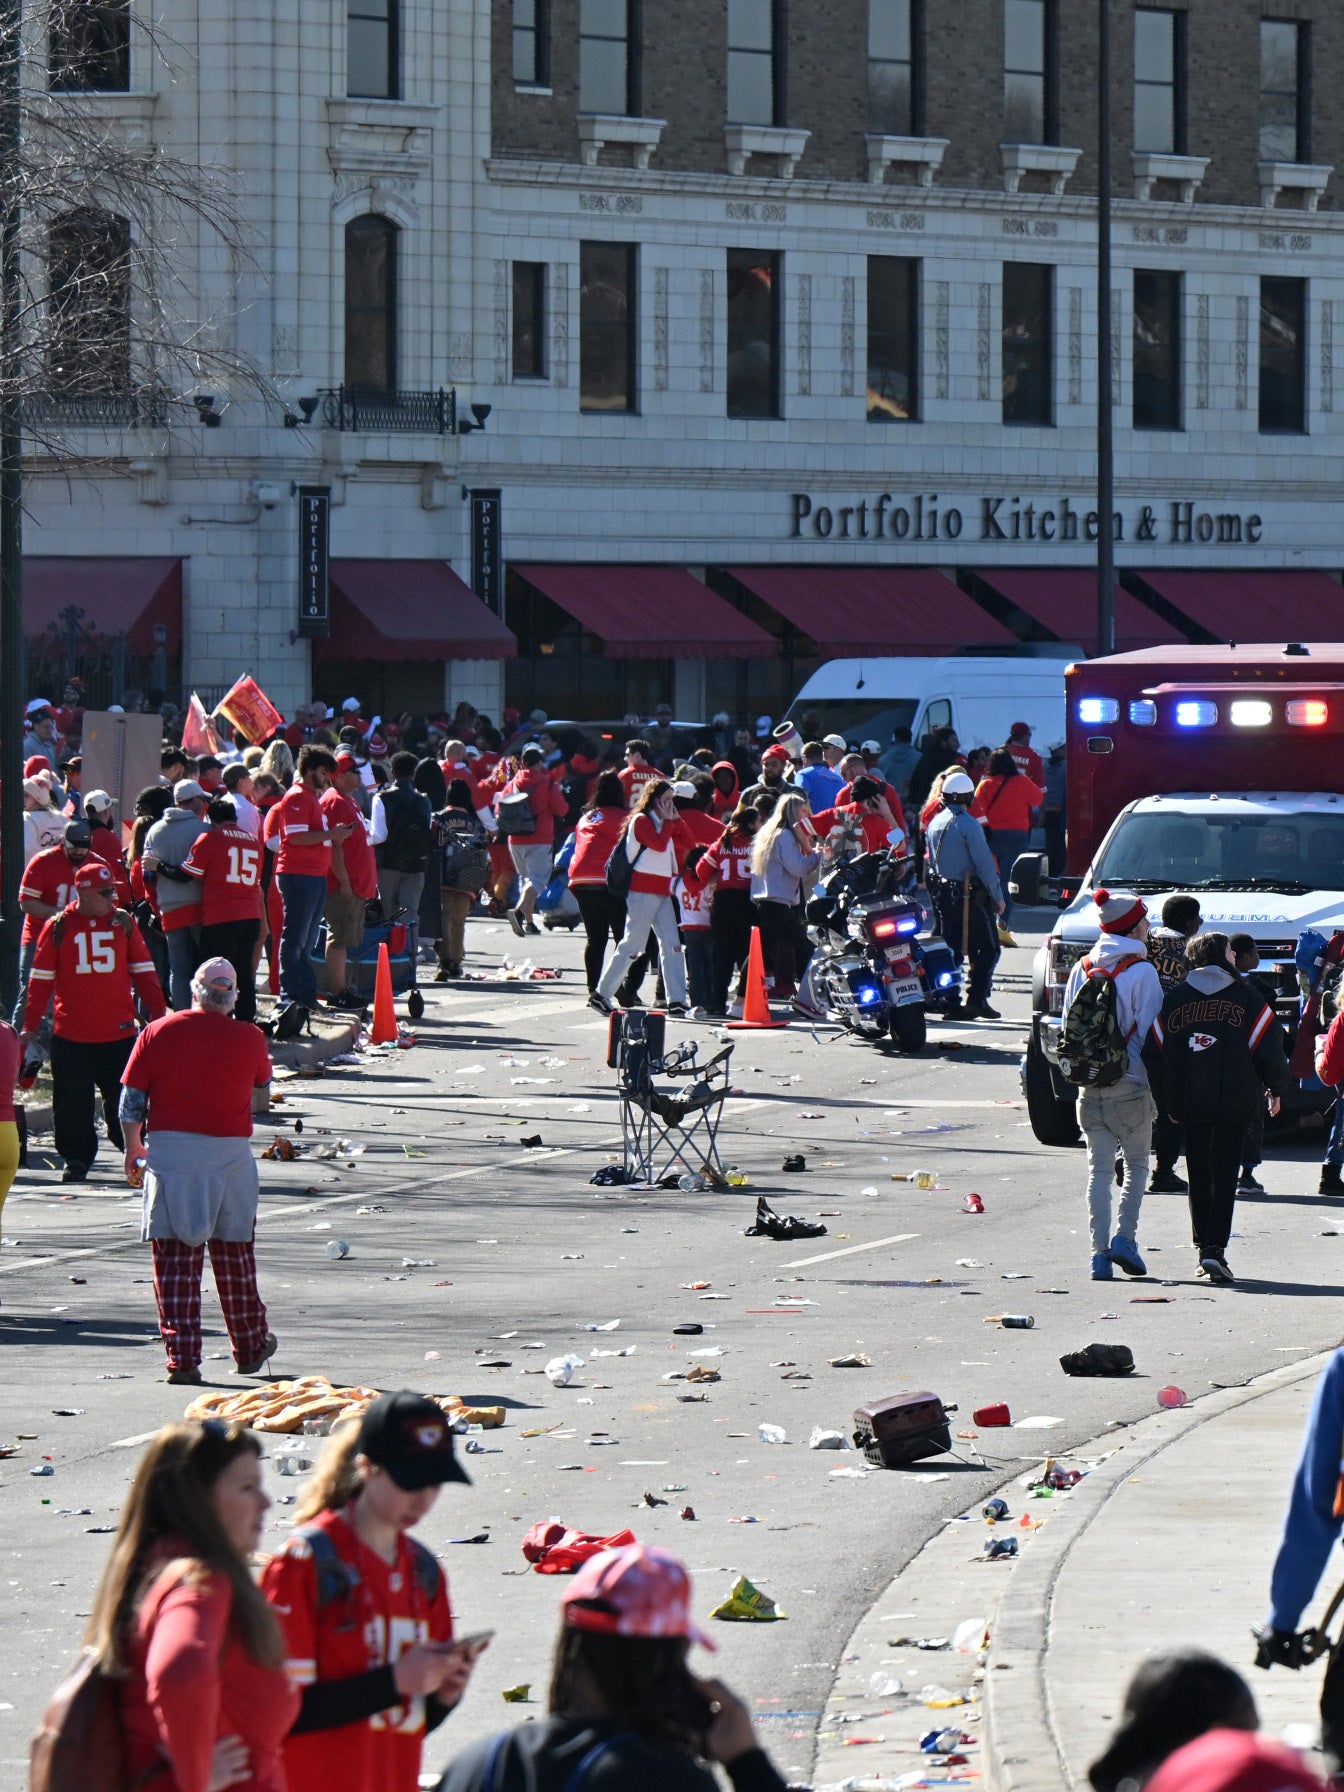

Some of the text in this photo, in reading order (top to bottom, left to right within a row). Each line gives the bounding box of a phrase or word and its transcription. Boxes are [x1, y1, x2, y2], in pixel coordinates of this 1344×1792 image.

[791, 493, 963, 539] Portfolio
[1135, 505, 1159, 541] &
[1169, 501, 1263, 544] Home
[309, 499, 319, 615] Portfolio
[481, 501, 491, 604] Portfoli
[225, 845, 260, 886] 15
[681, 891, 702, 912] 87
[74, 931, 116, 975] 15
[895, 983, 918, 995] POLICE
[1167, 999, 1245, 1034] CHIEFS
